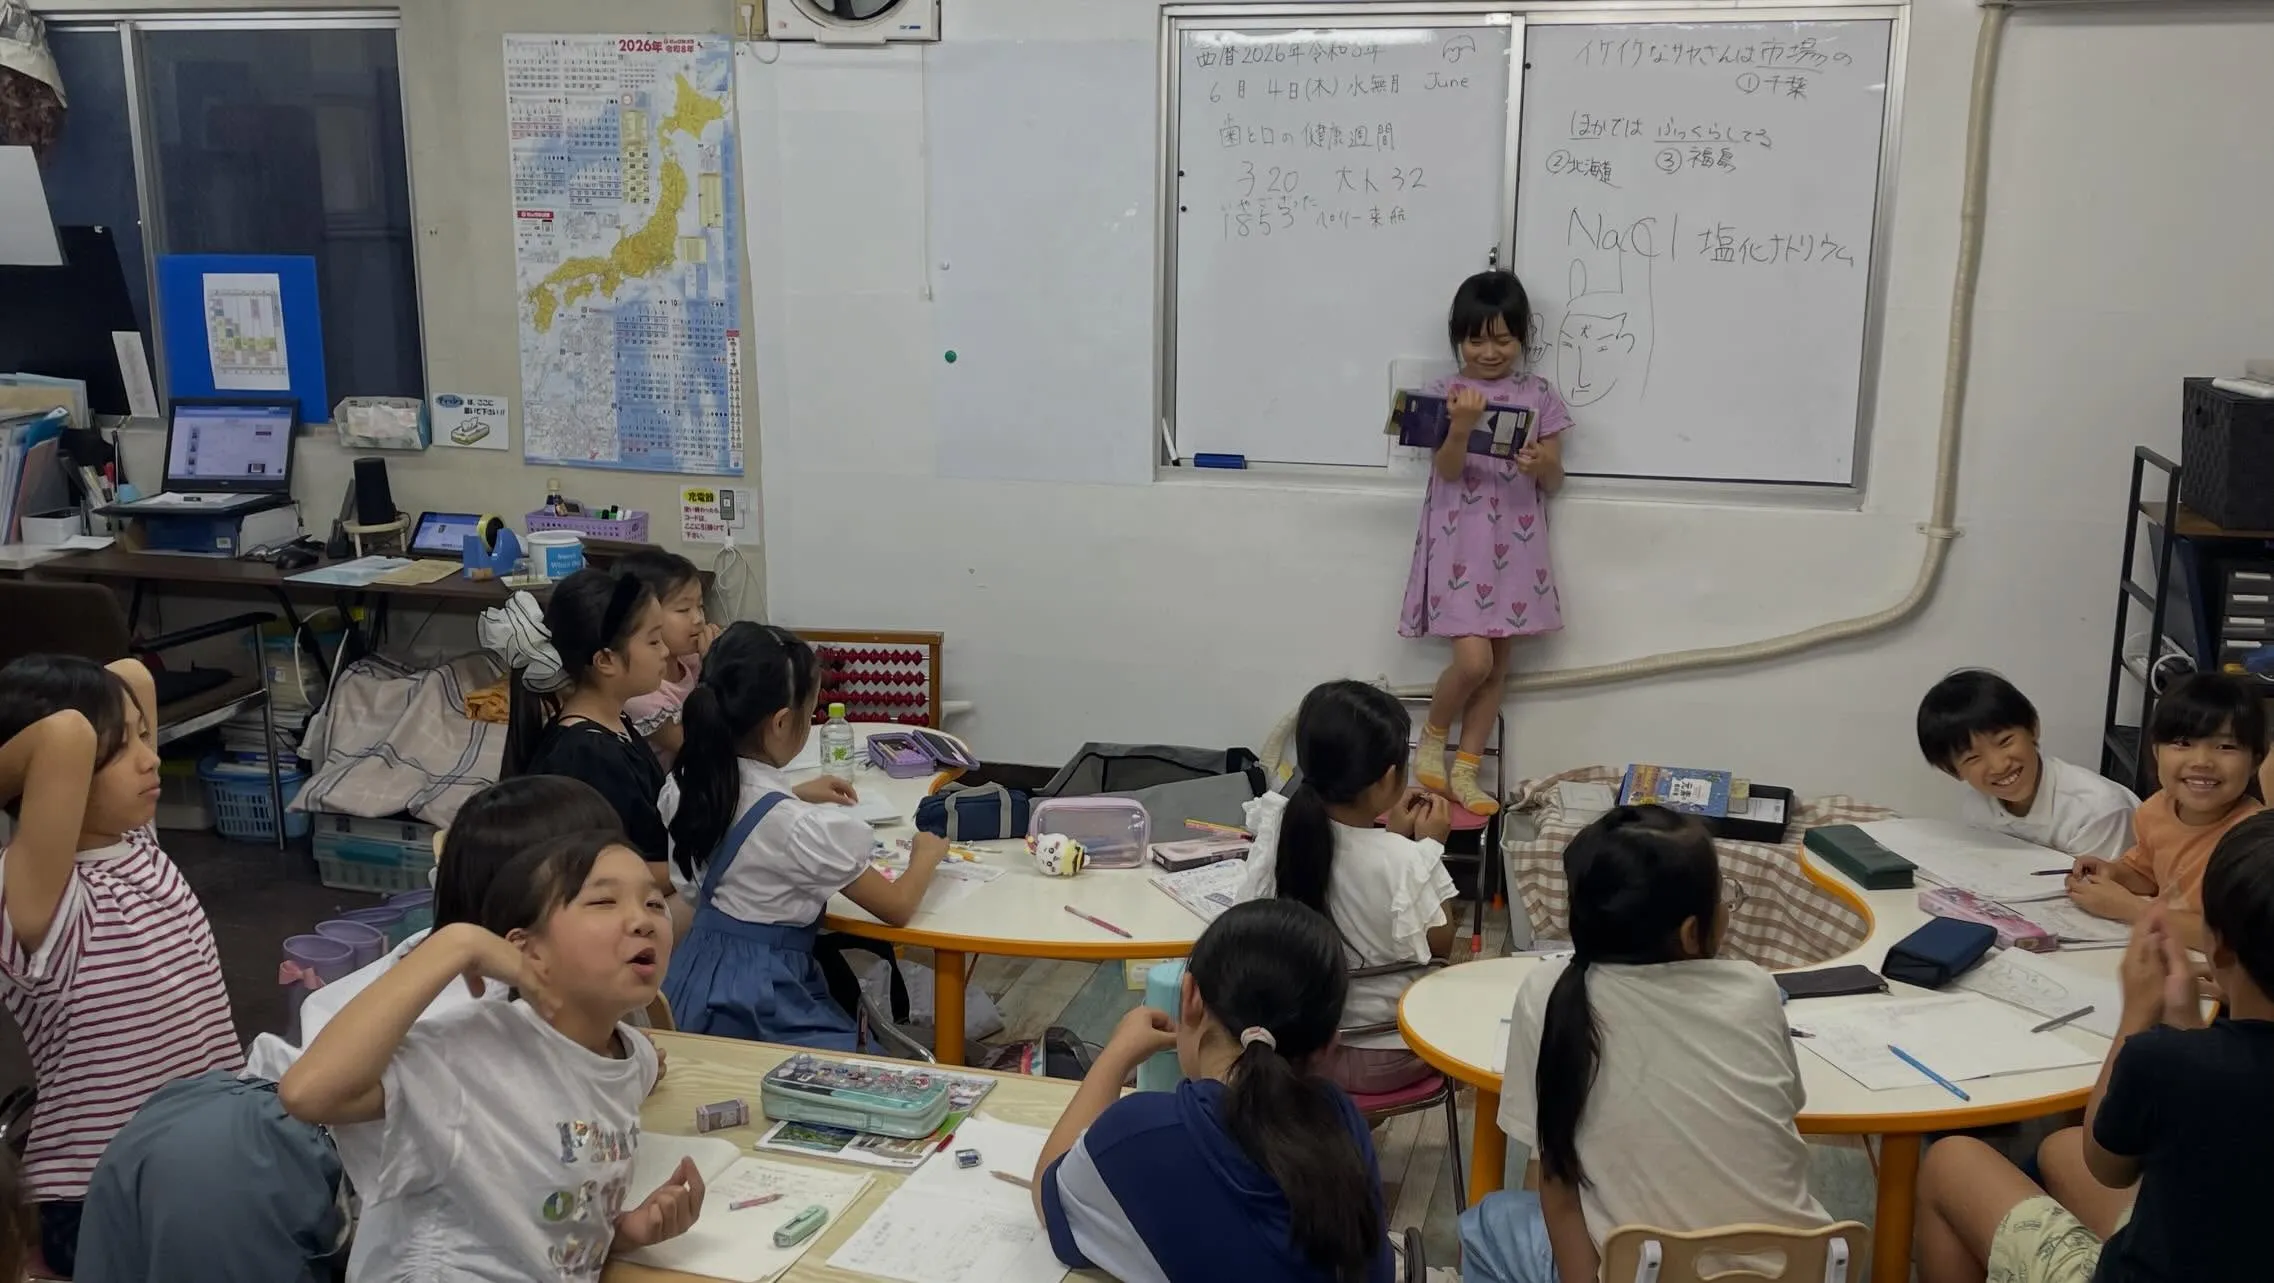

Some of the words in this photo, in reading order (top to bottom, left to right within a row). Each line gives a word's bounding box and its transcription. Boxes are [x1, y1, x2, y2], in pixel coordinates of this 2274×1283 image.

[619, 39, 663, 53] 2026年
[1424, 71, 1471, 90] June
[1218, 113, 1396, 151] 歯と口の健康週間
